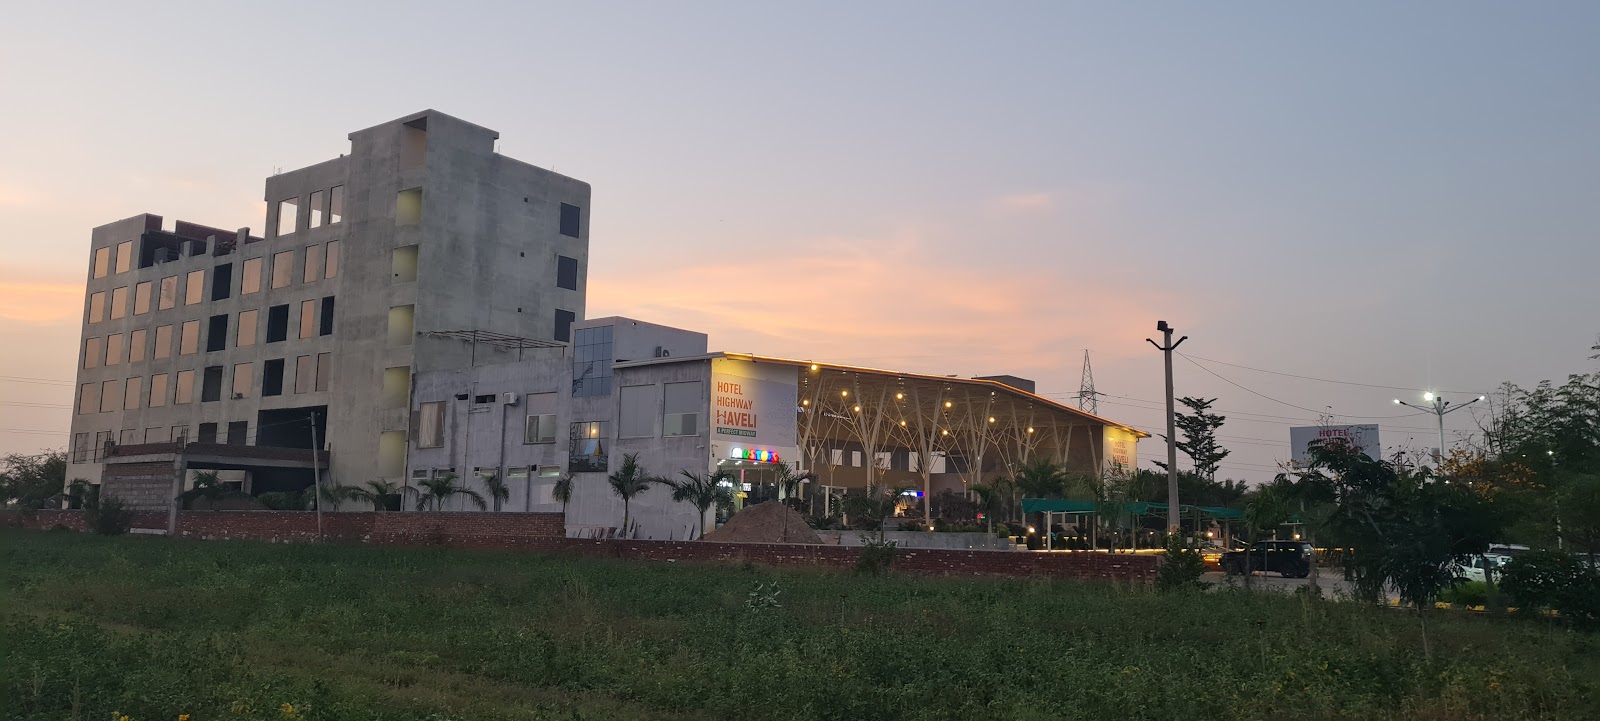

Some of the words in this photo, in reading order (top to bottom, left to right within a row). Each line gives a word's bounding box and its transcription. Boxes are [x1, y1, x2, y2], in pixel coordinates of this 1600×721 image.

[717, 381, 743, 395] HOTEL
[717, 396, 753, 410] HIGHWAY
[717, 410, 756, 428] HAVELI
